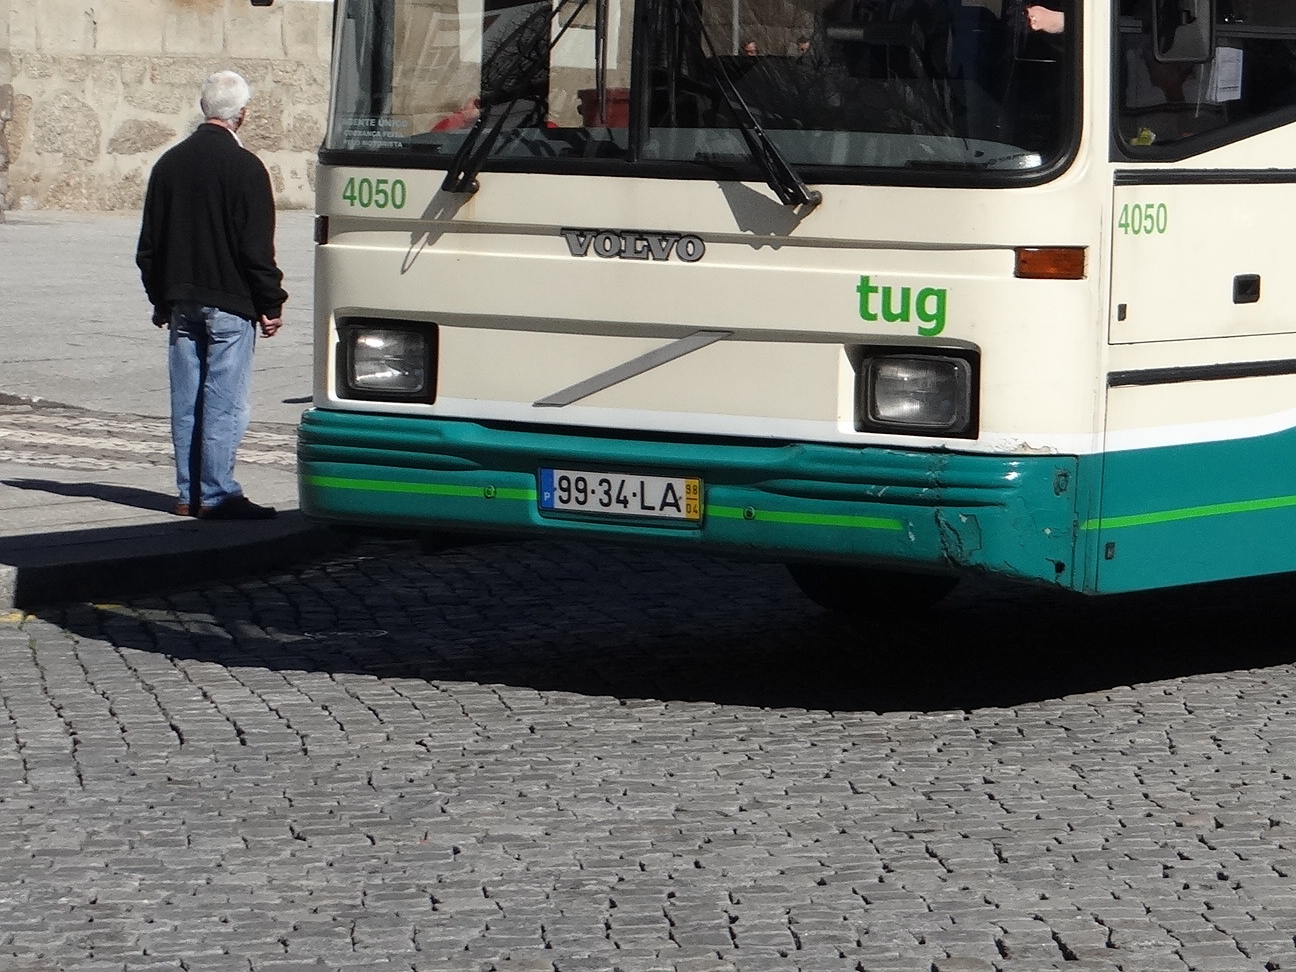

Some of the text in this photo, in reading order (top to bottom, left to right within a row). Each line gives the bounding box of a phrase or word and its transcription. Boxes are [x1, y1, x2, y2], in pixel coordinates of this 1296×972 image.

[342, 177, 407, 209] 4050
[1117, 202, 1168, 235] 4050
[562, 228, 706, 263] VOLVO
[856, 275, 947, 336] tug
[543, 491, 550, 501] P
[685, 484, 698, 495] 98
[686, 506, 698, 514] 04
